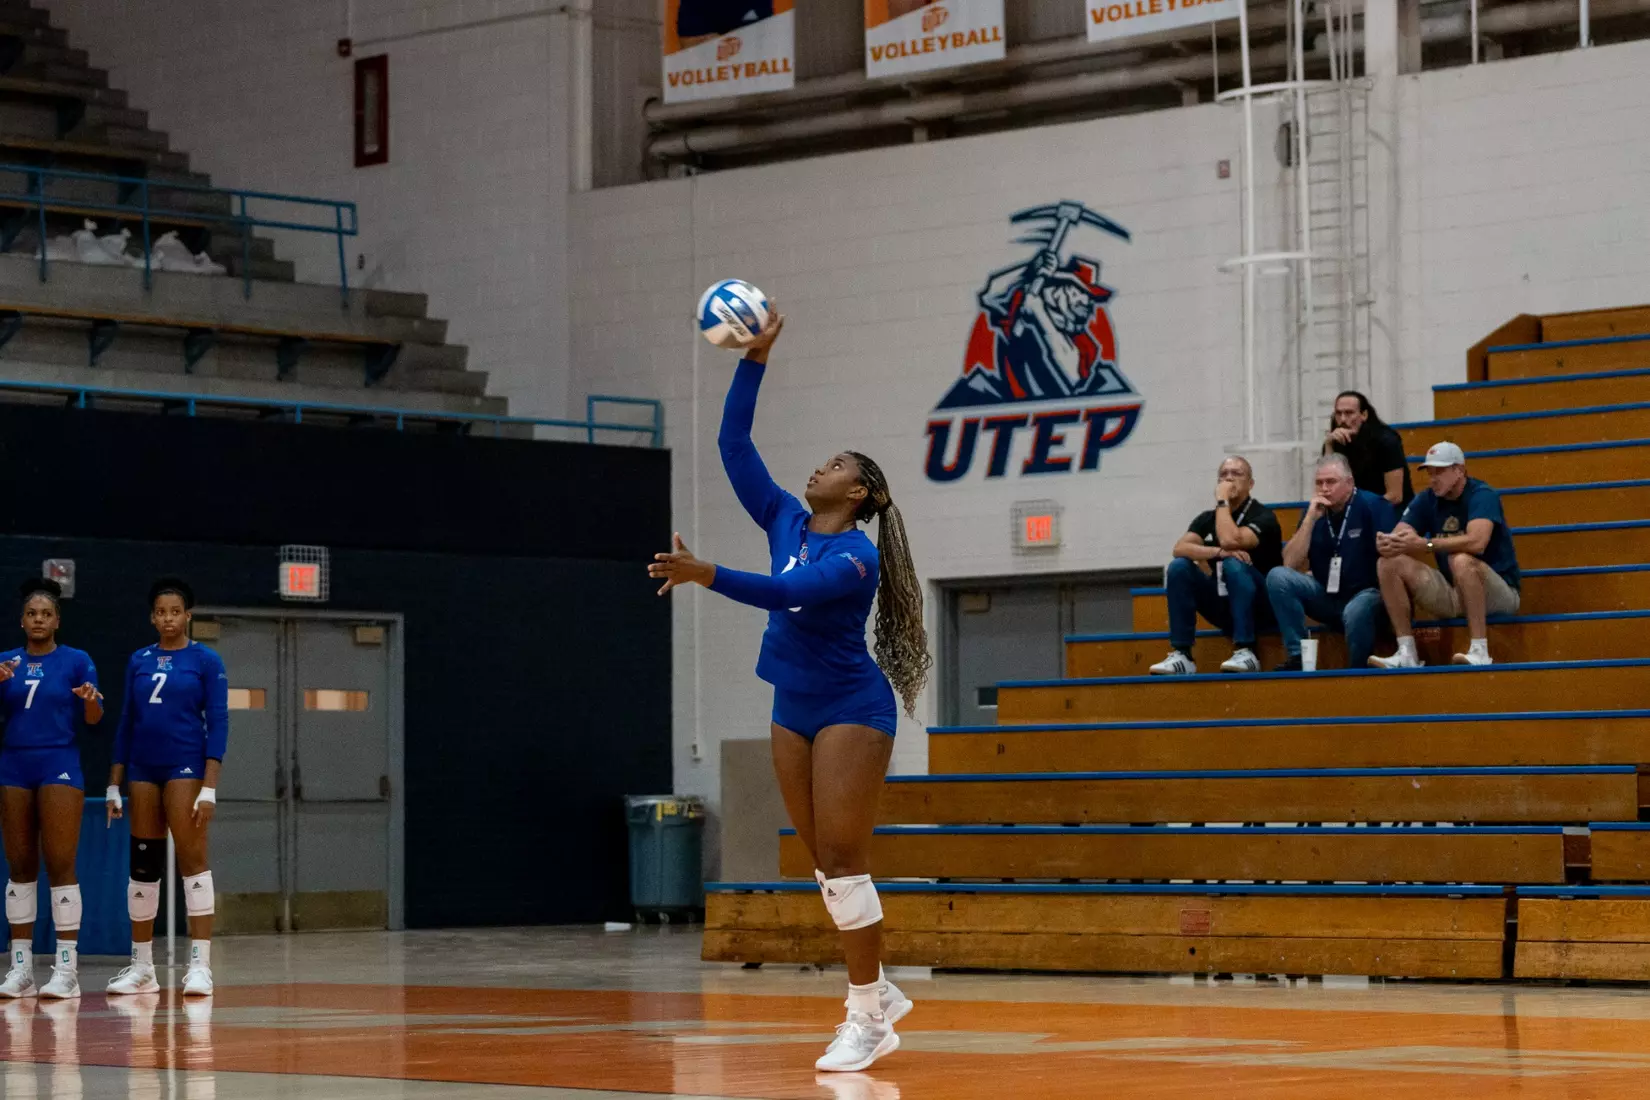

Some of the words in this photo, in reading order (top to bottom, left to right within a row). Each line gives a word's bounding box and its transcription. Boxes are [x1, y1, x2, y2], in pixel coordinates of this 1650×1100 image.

[1091, 0, 1224, 25] VOLLEYB
[871, 25, 1001, 62] VOLLEYBALL
[668, 57, 792, 88] VOLLEYBALL
[924, 402, 1144, 483] UTEP
[24, 679, 40, 709] 7
[148, 672, 167, 704] 2
